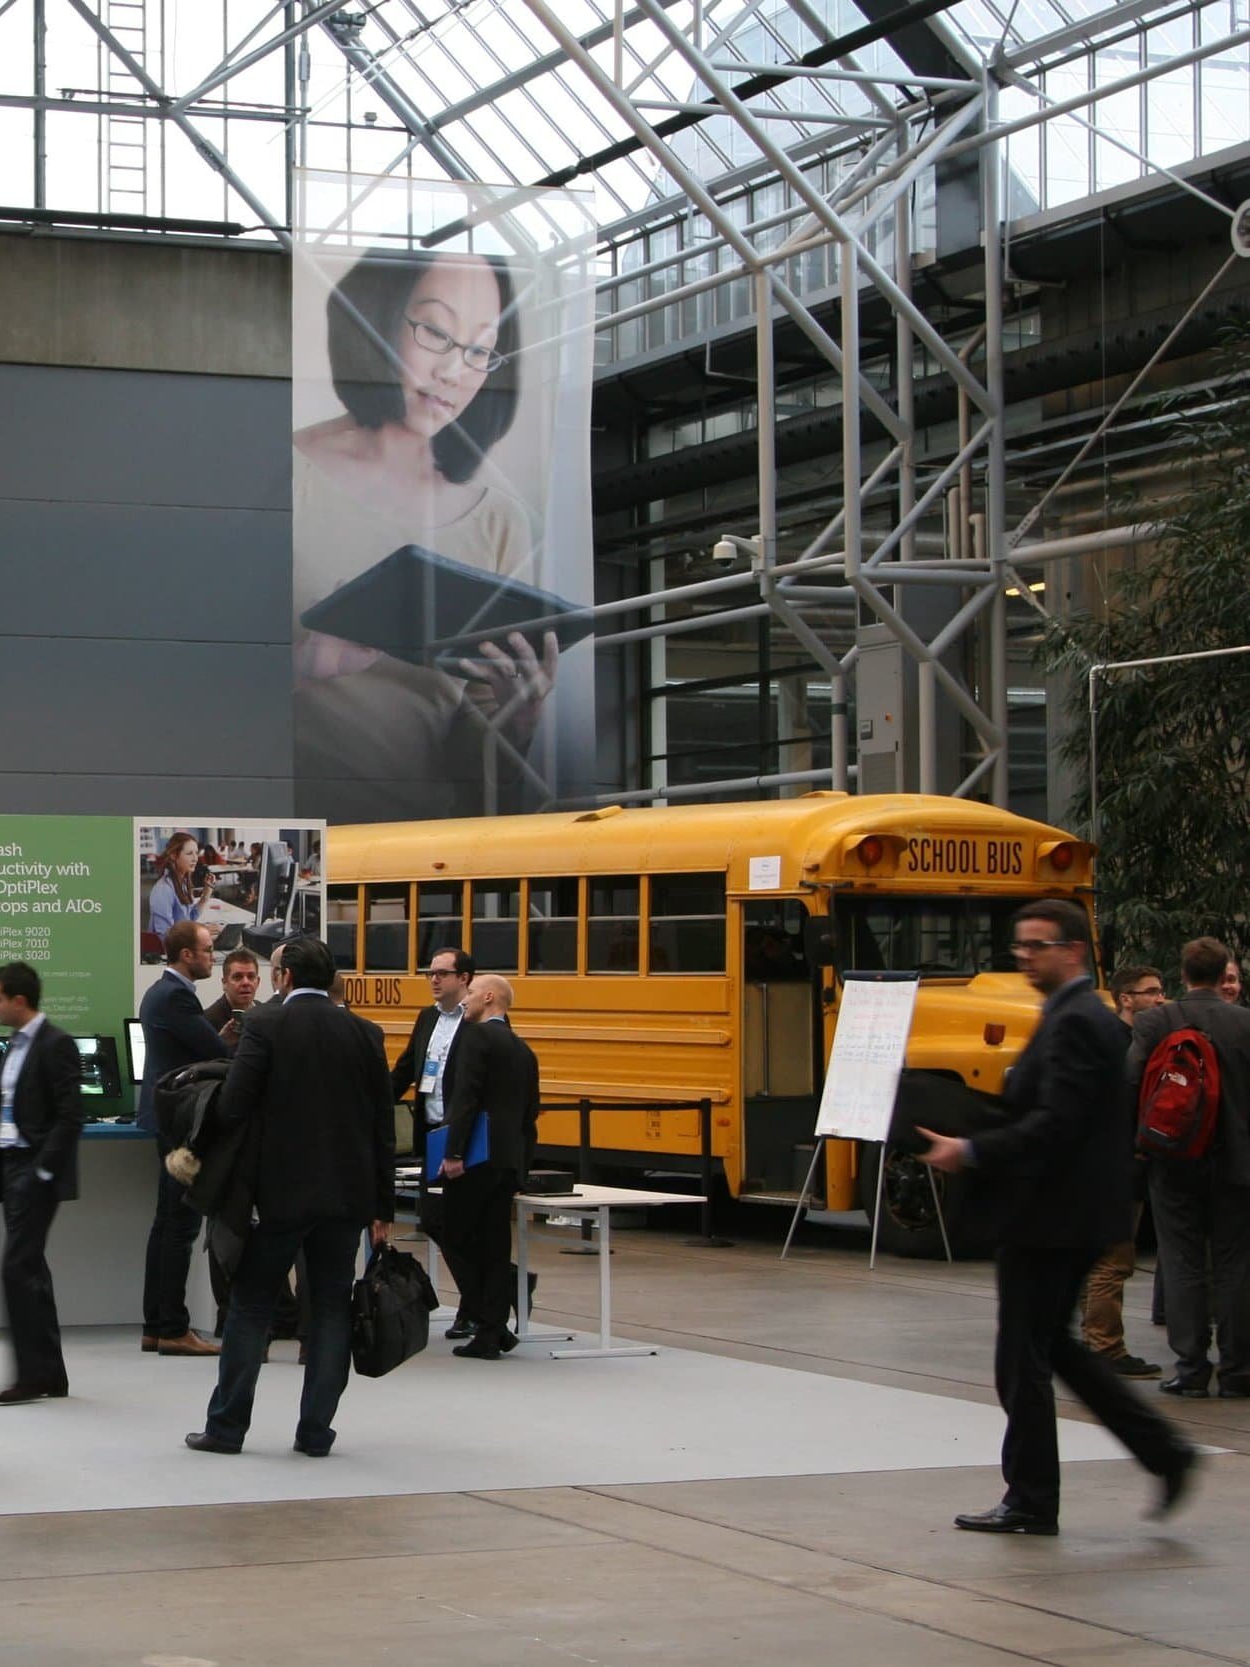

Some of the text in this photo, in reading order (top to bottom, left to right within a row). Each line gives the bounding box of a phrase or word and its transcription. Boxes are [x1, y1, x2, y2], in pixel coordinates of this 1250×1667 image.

[908, 838, 1022, 875] SCHOOL BUS
[56, 862, 91, 876] with
[32, 898, 62, 913] and
[65, 899, 103, 913] AIOs
[25, 926, 51, 937] 9020
[25, 938, 50, 949] 7010
[25, 950, 51, 961] 3020
[344, 978, 401, 1005] OOL BUS
